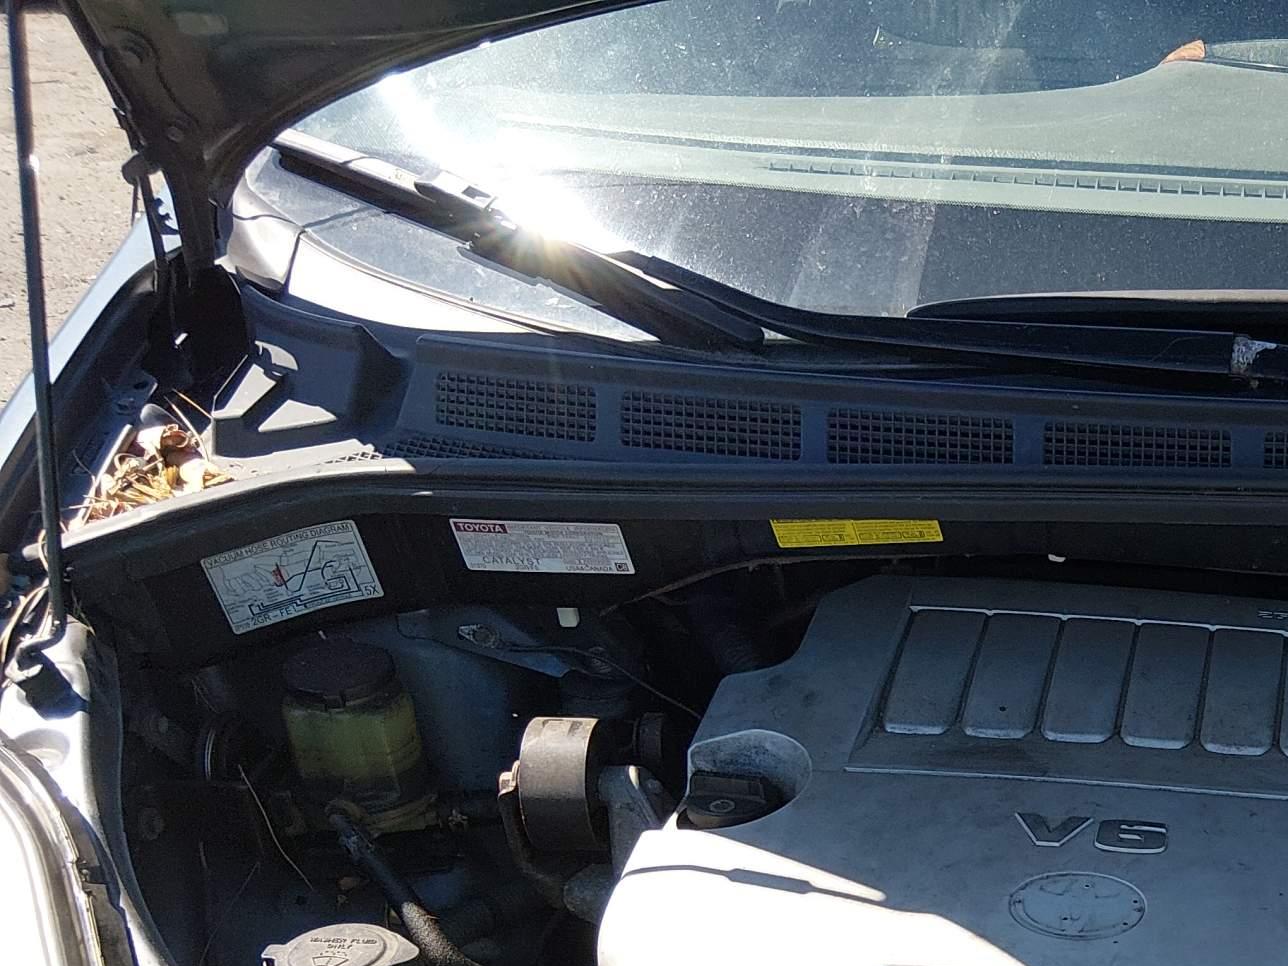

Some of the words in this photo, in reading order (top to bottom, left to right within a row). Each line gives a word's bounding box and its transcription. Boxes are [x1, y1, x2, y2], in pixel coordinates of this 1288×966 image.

[456, 523, 504, 532] TOYOTA
[207, 549, 245, 567] VACUUM
[245, 542, 270, 556] HOSE
[270, 531, 309, 549] ROUTING
[310, 523, 351, 537] DIAGRAM
[482, 556, 541, 566] CATALYST
[364, 584, 379, 597] 5X
[1015, 811, 1168, 854] V6
